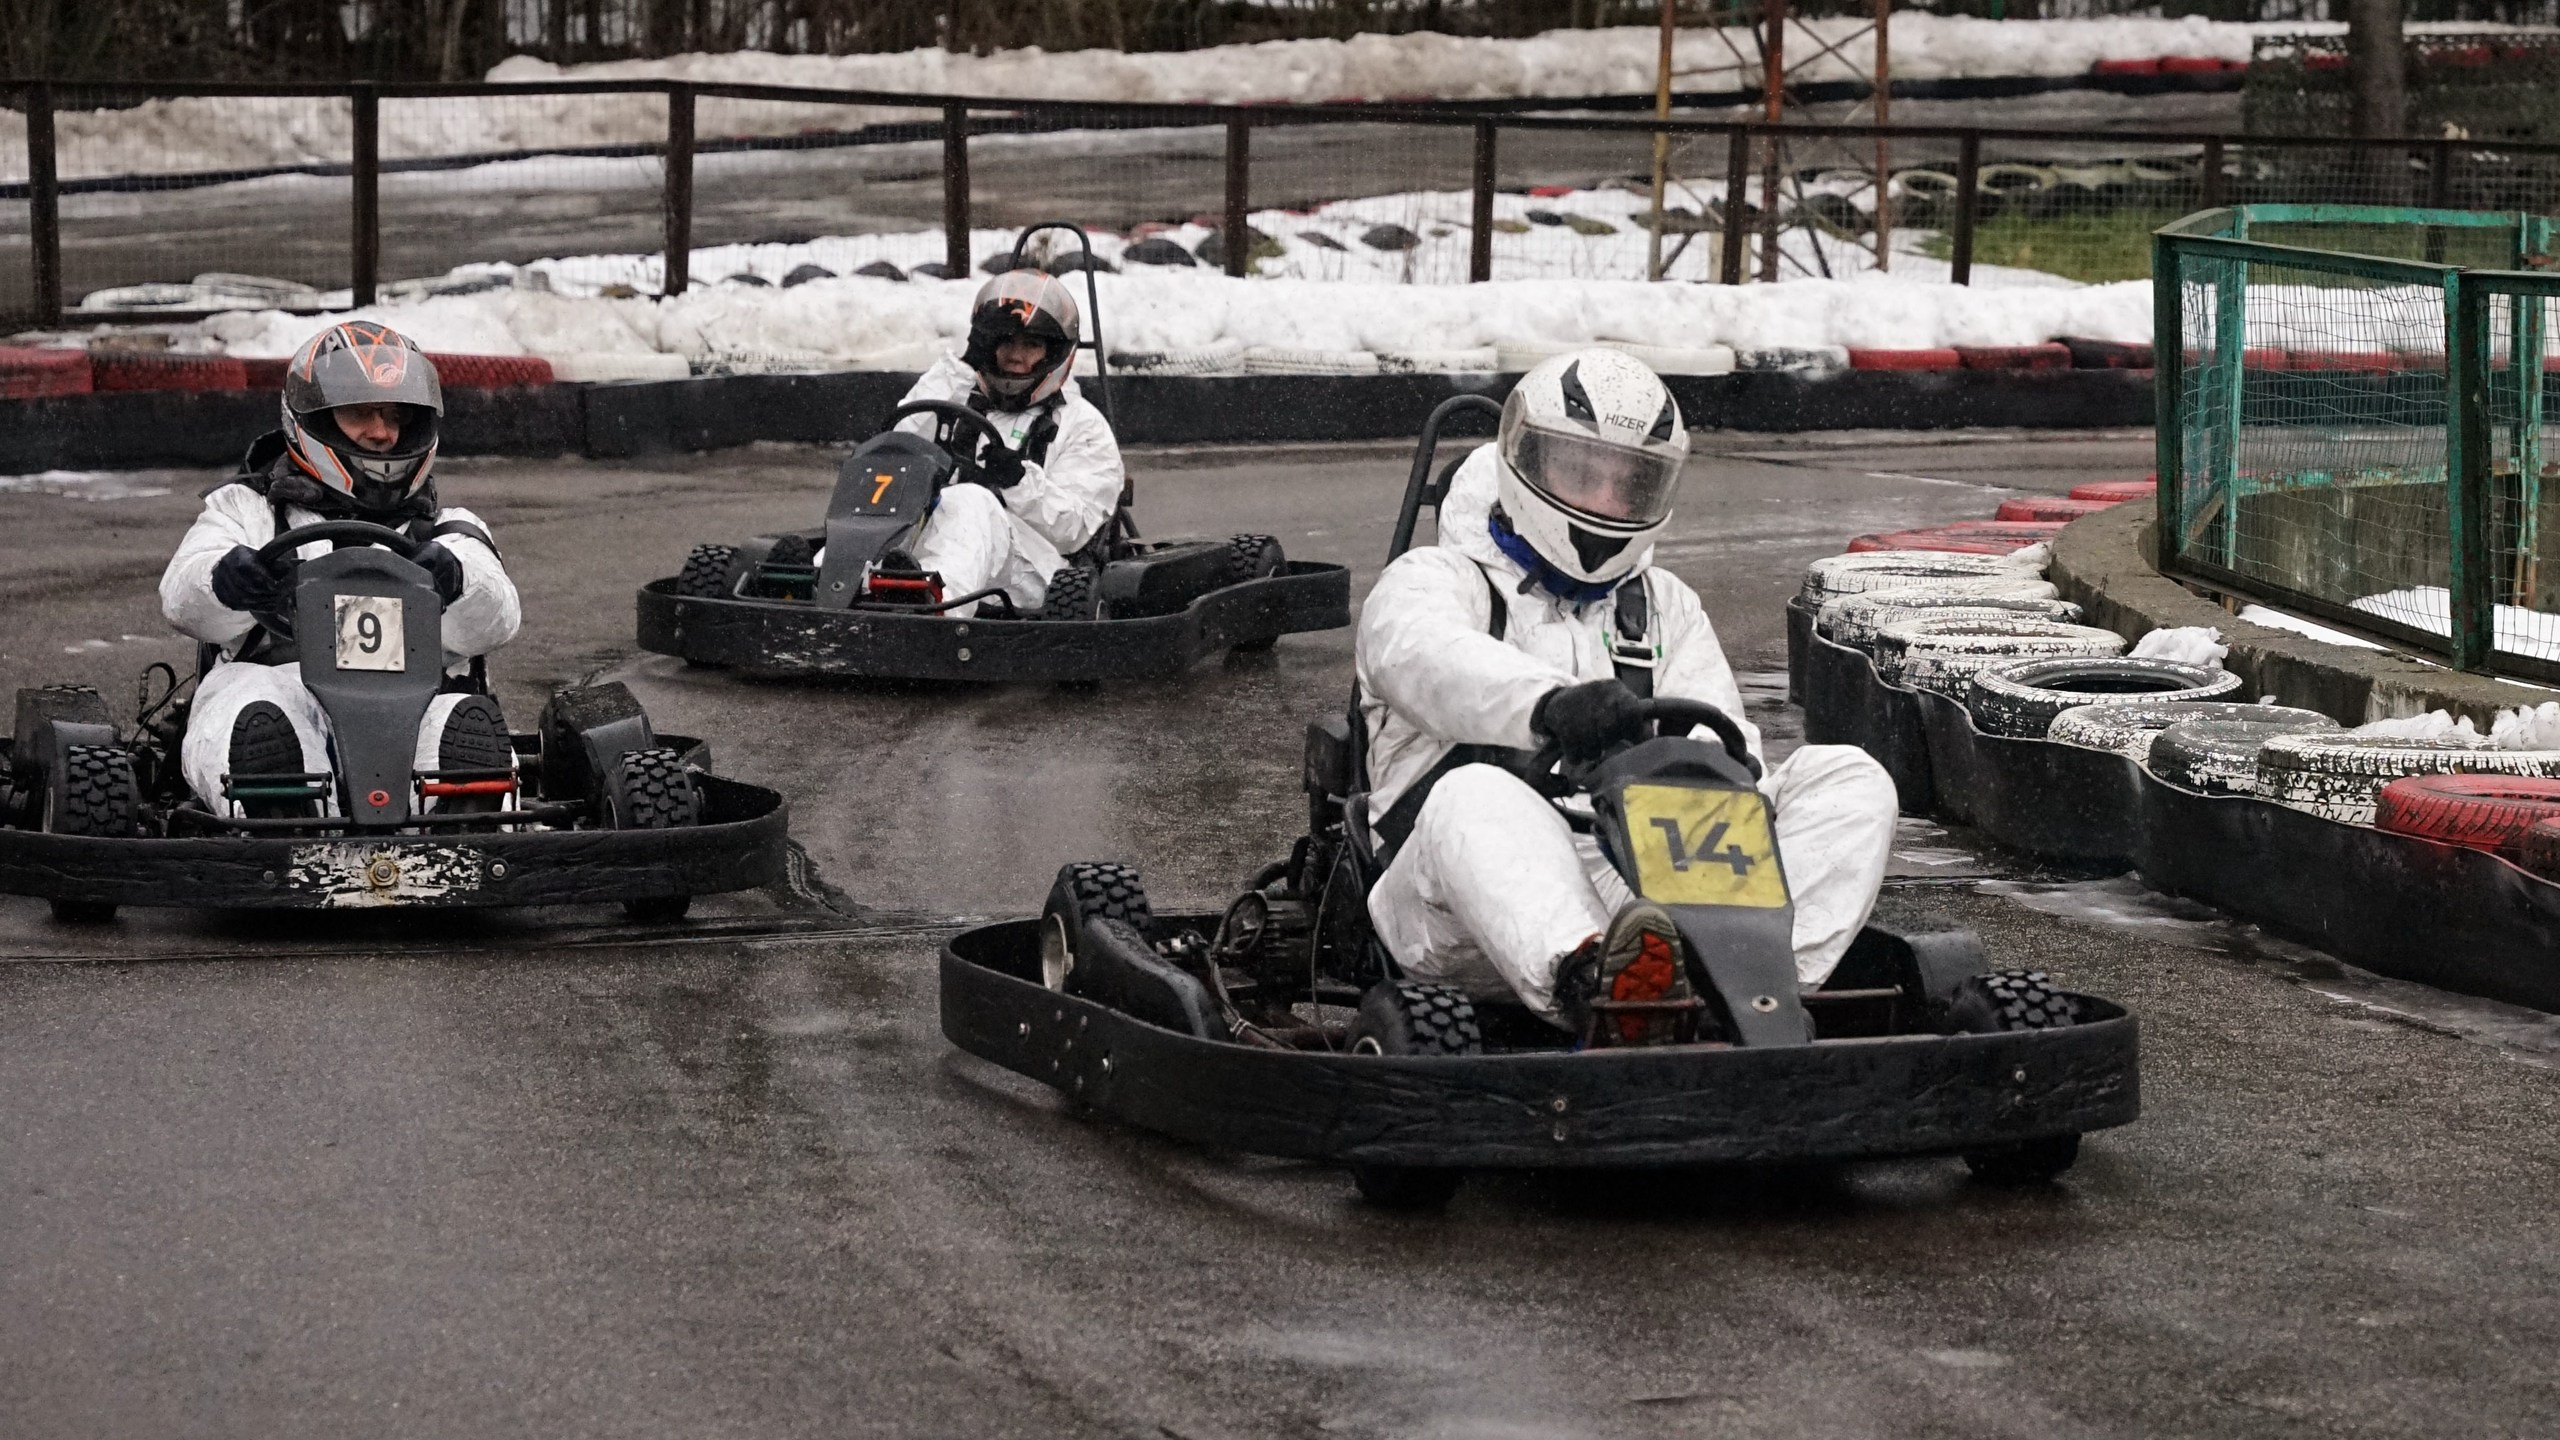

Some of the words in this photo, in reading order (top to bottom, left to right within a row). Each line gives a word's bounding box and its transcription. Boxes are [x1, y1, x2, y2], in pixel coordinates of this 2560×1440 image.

[1604, 413, 1647, 432] HIZER
[871, 475, 894, 504] 7
[357, 612, 382, 654] 9
[1650, 818, 1755, 876] 14
